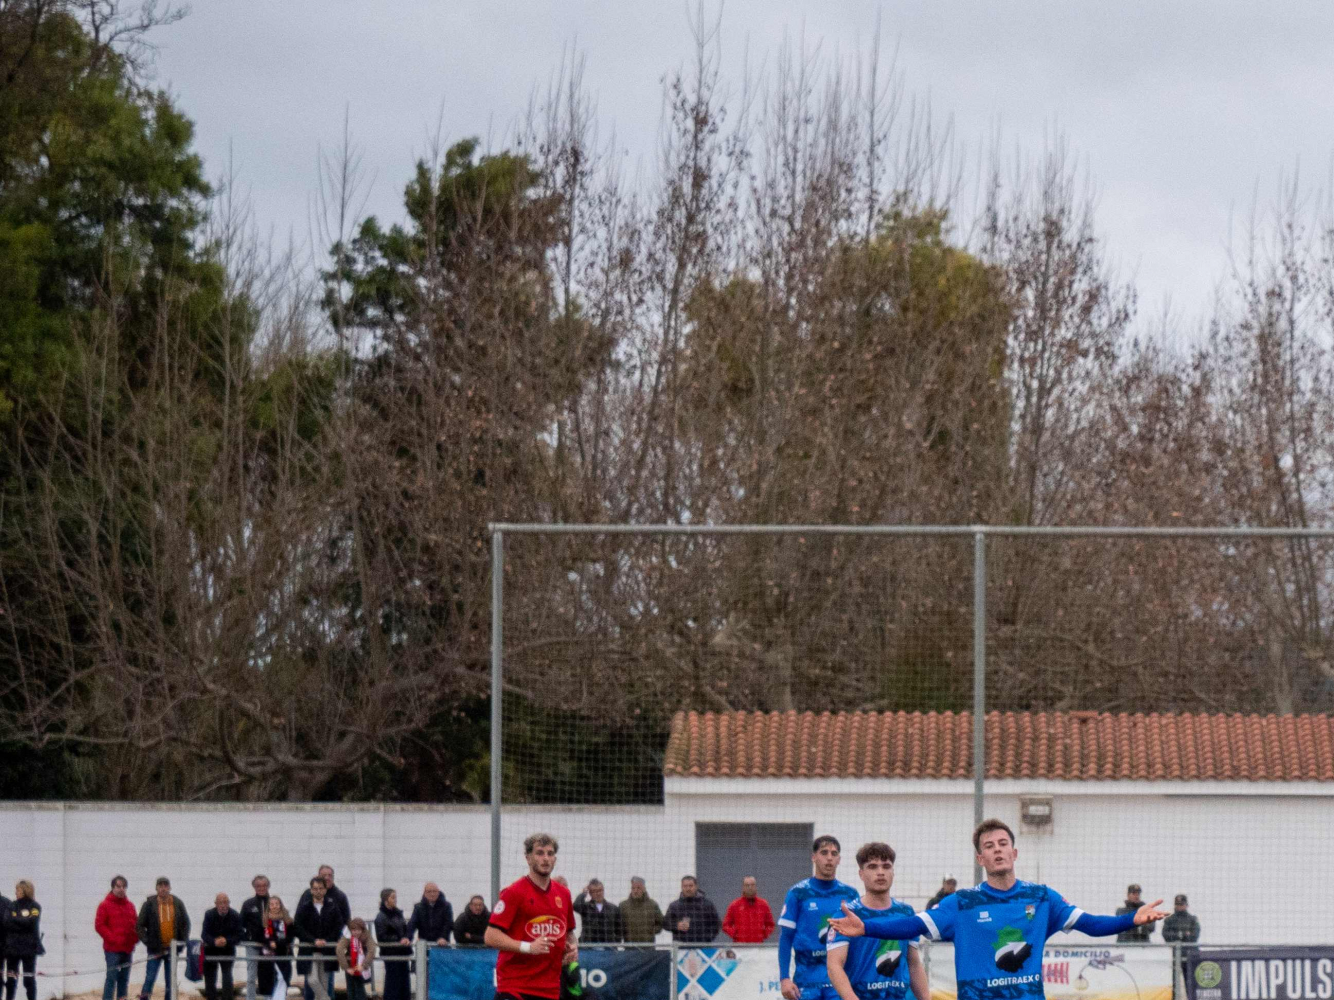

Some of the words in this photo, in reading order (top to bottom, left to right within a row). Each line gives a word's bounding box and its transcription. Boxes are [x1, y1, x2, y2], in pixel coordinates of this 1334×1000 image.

[531, 919, 561, 940] apis
[1054, 949, 1111, 959] DOMICILIO
[987, 974, 1034, 987] LOGITRAEX
